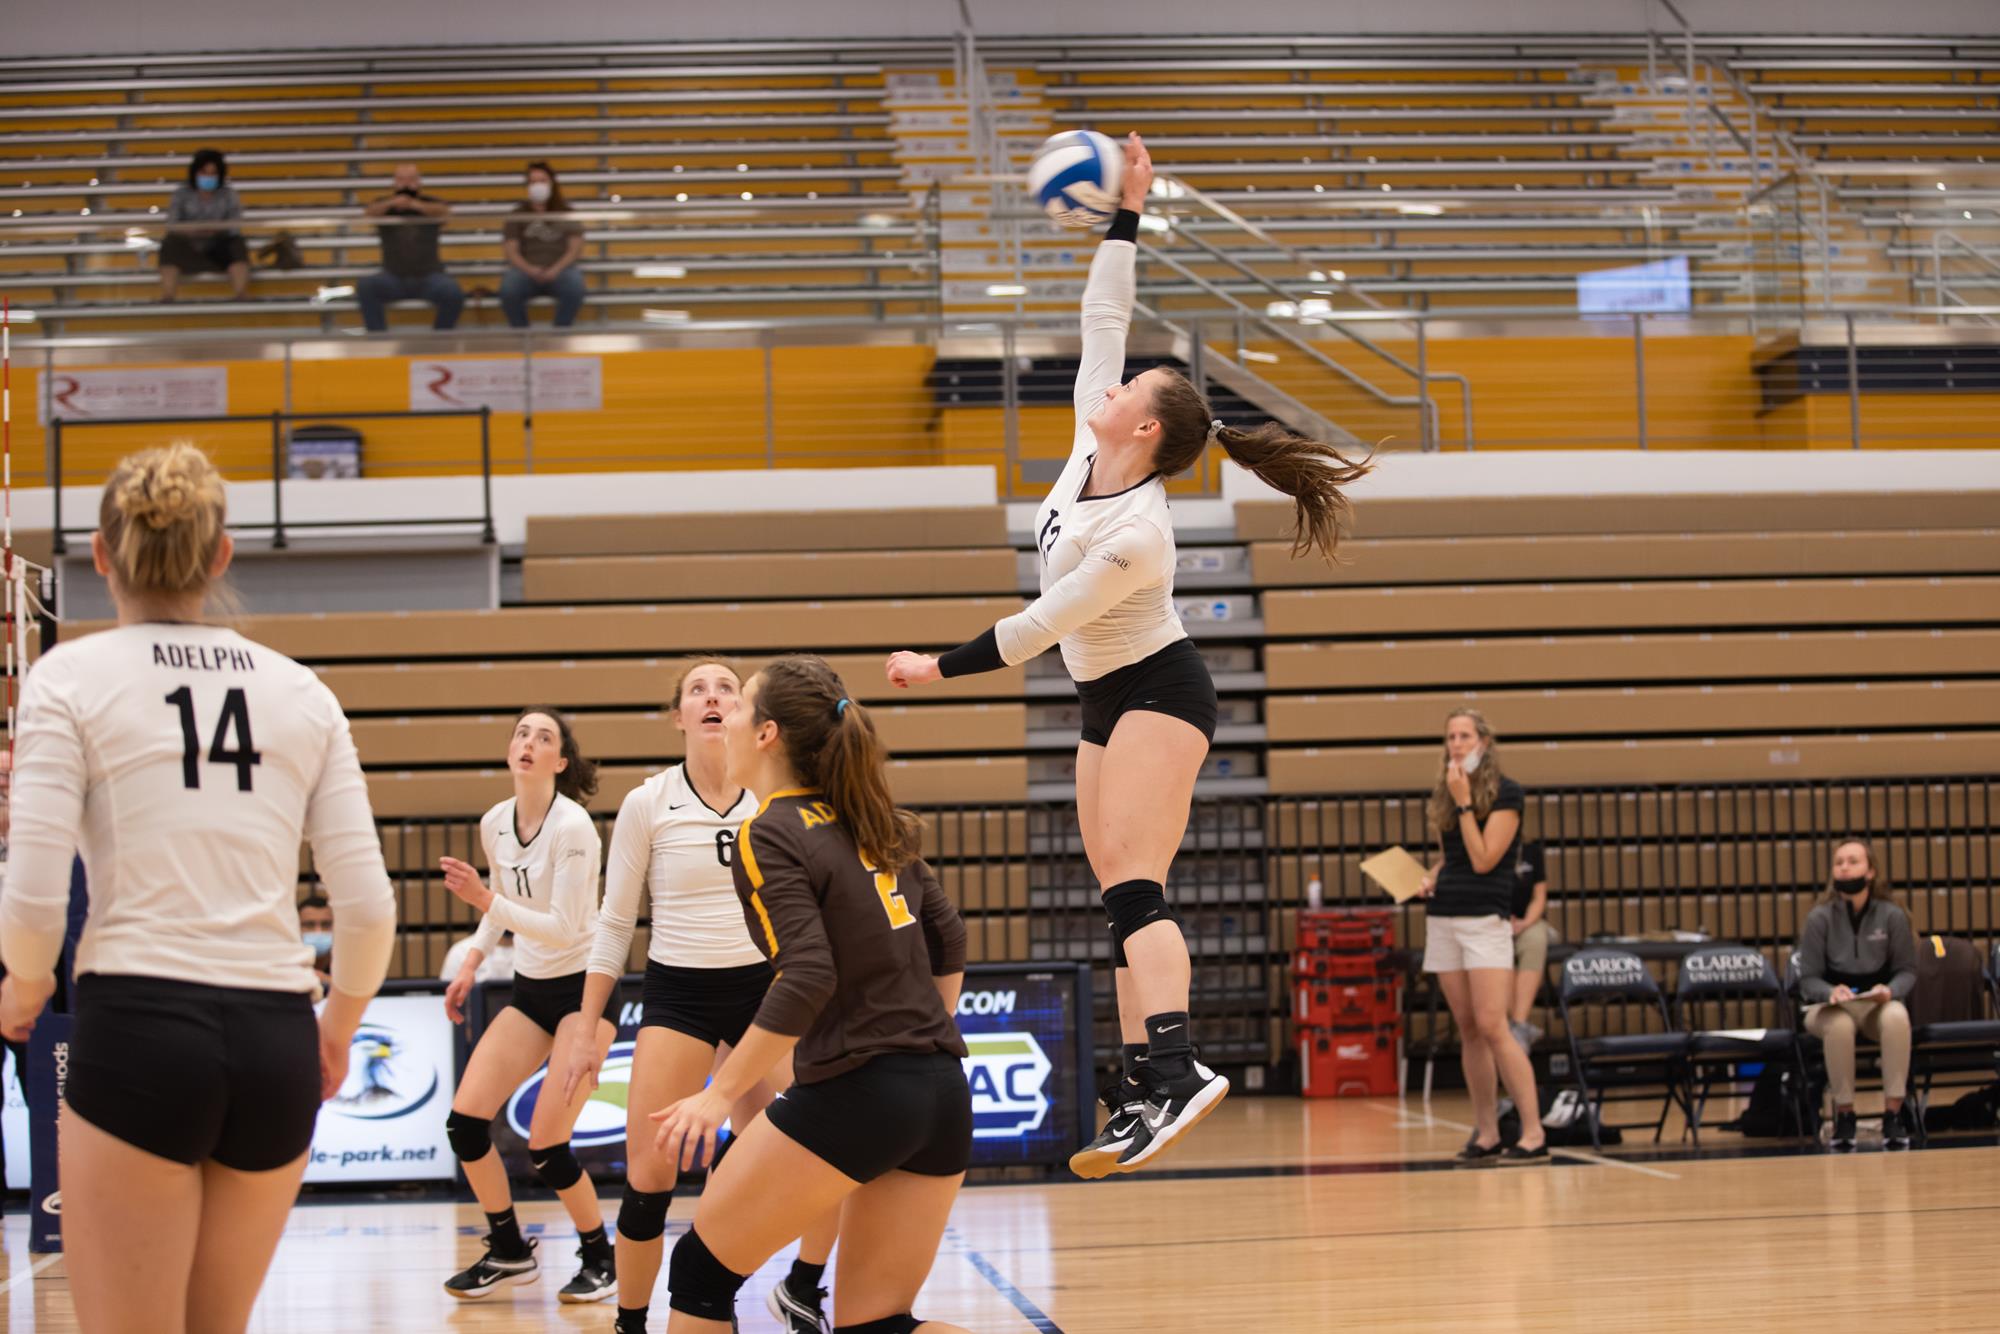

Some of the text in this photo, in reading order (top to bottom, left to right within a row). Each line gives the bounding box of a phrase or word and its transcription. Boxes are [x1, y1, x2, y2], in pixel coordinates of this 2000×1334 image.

[152, 642, 256, 671] ADELPHI
[164, 685, 262, 793] 14
[715, 829, 734, 867] 6
[511, 865, 533, 898] 11
[1566, 956, 1643, 973] CLARION
[1685, 953, 1765, 972] CLARION
[1571, 972, 1644, 987] UNIVERSITY
[1688, 969, 1765, 984] UNIVERSITY
